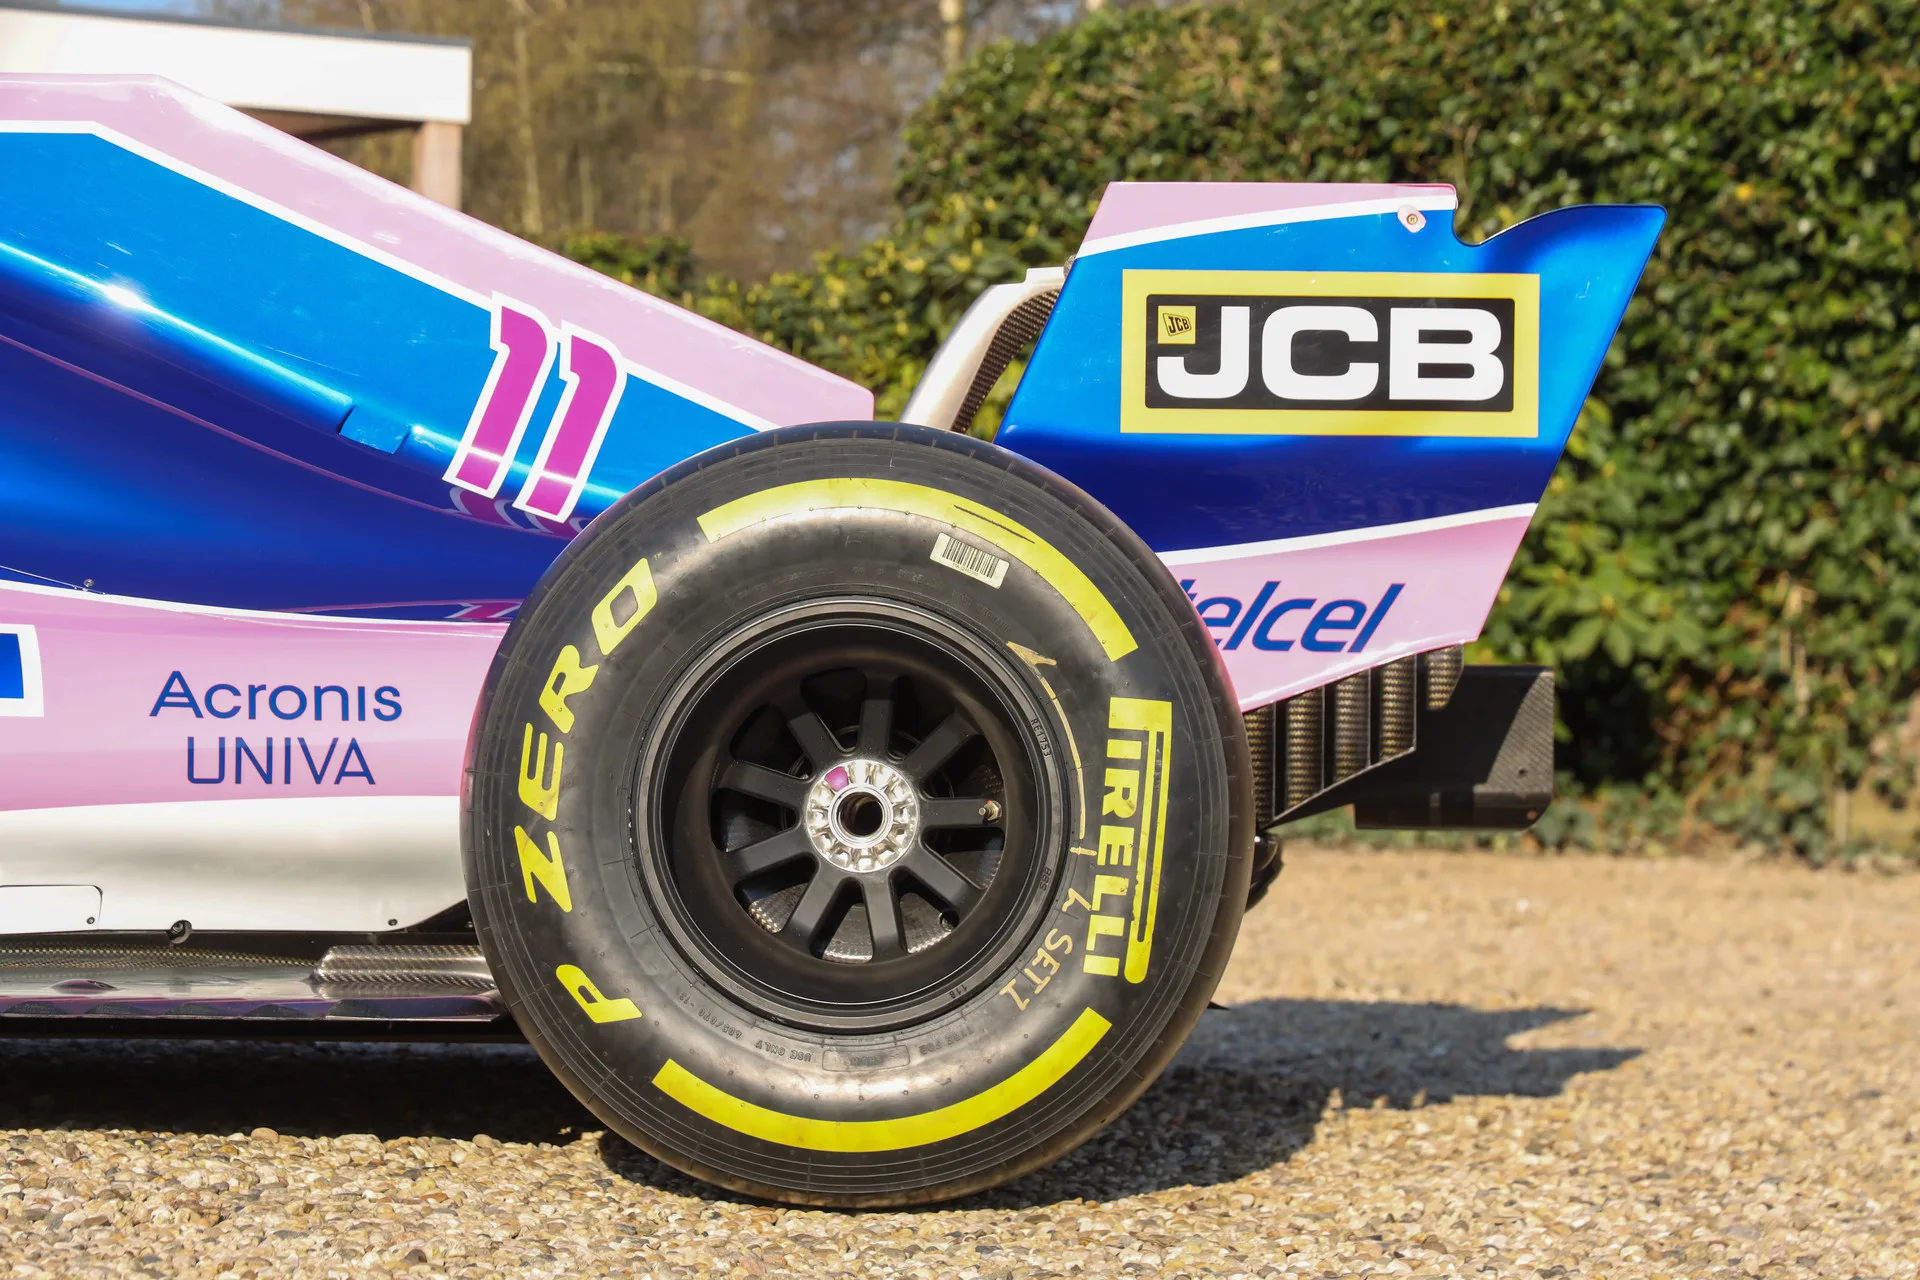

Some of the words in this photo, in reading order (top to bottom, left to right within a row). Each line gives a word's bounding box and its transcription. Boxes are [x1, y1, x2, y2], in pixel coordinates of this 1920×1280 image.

[1168, 316, 1189, 333] JCB
[1157, 305, 1504, 401] JCB
[446, 294, 624, 521] 11
[149, 670, 403, 722] Acronis
[187, 737, 376, 785] UNIVA
[514, 557, 658, 913] ZERO
[1031, 718, 1052, 757] RE1753
[1082, 697, 1172, 984] PIRELLI
[556, 964, 643, 1024] P
[755, 1039, 786, 1056] ONLY
[790, 1049, 812, 1062] USE
